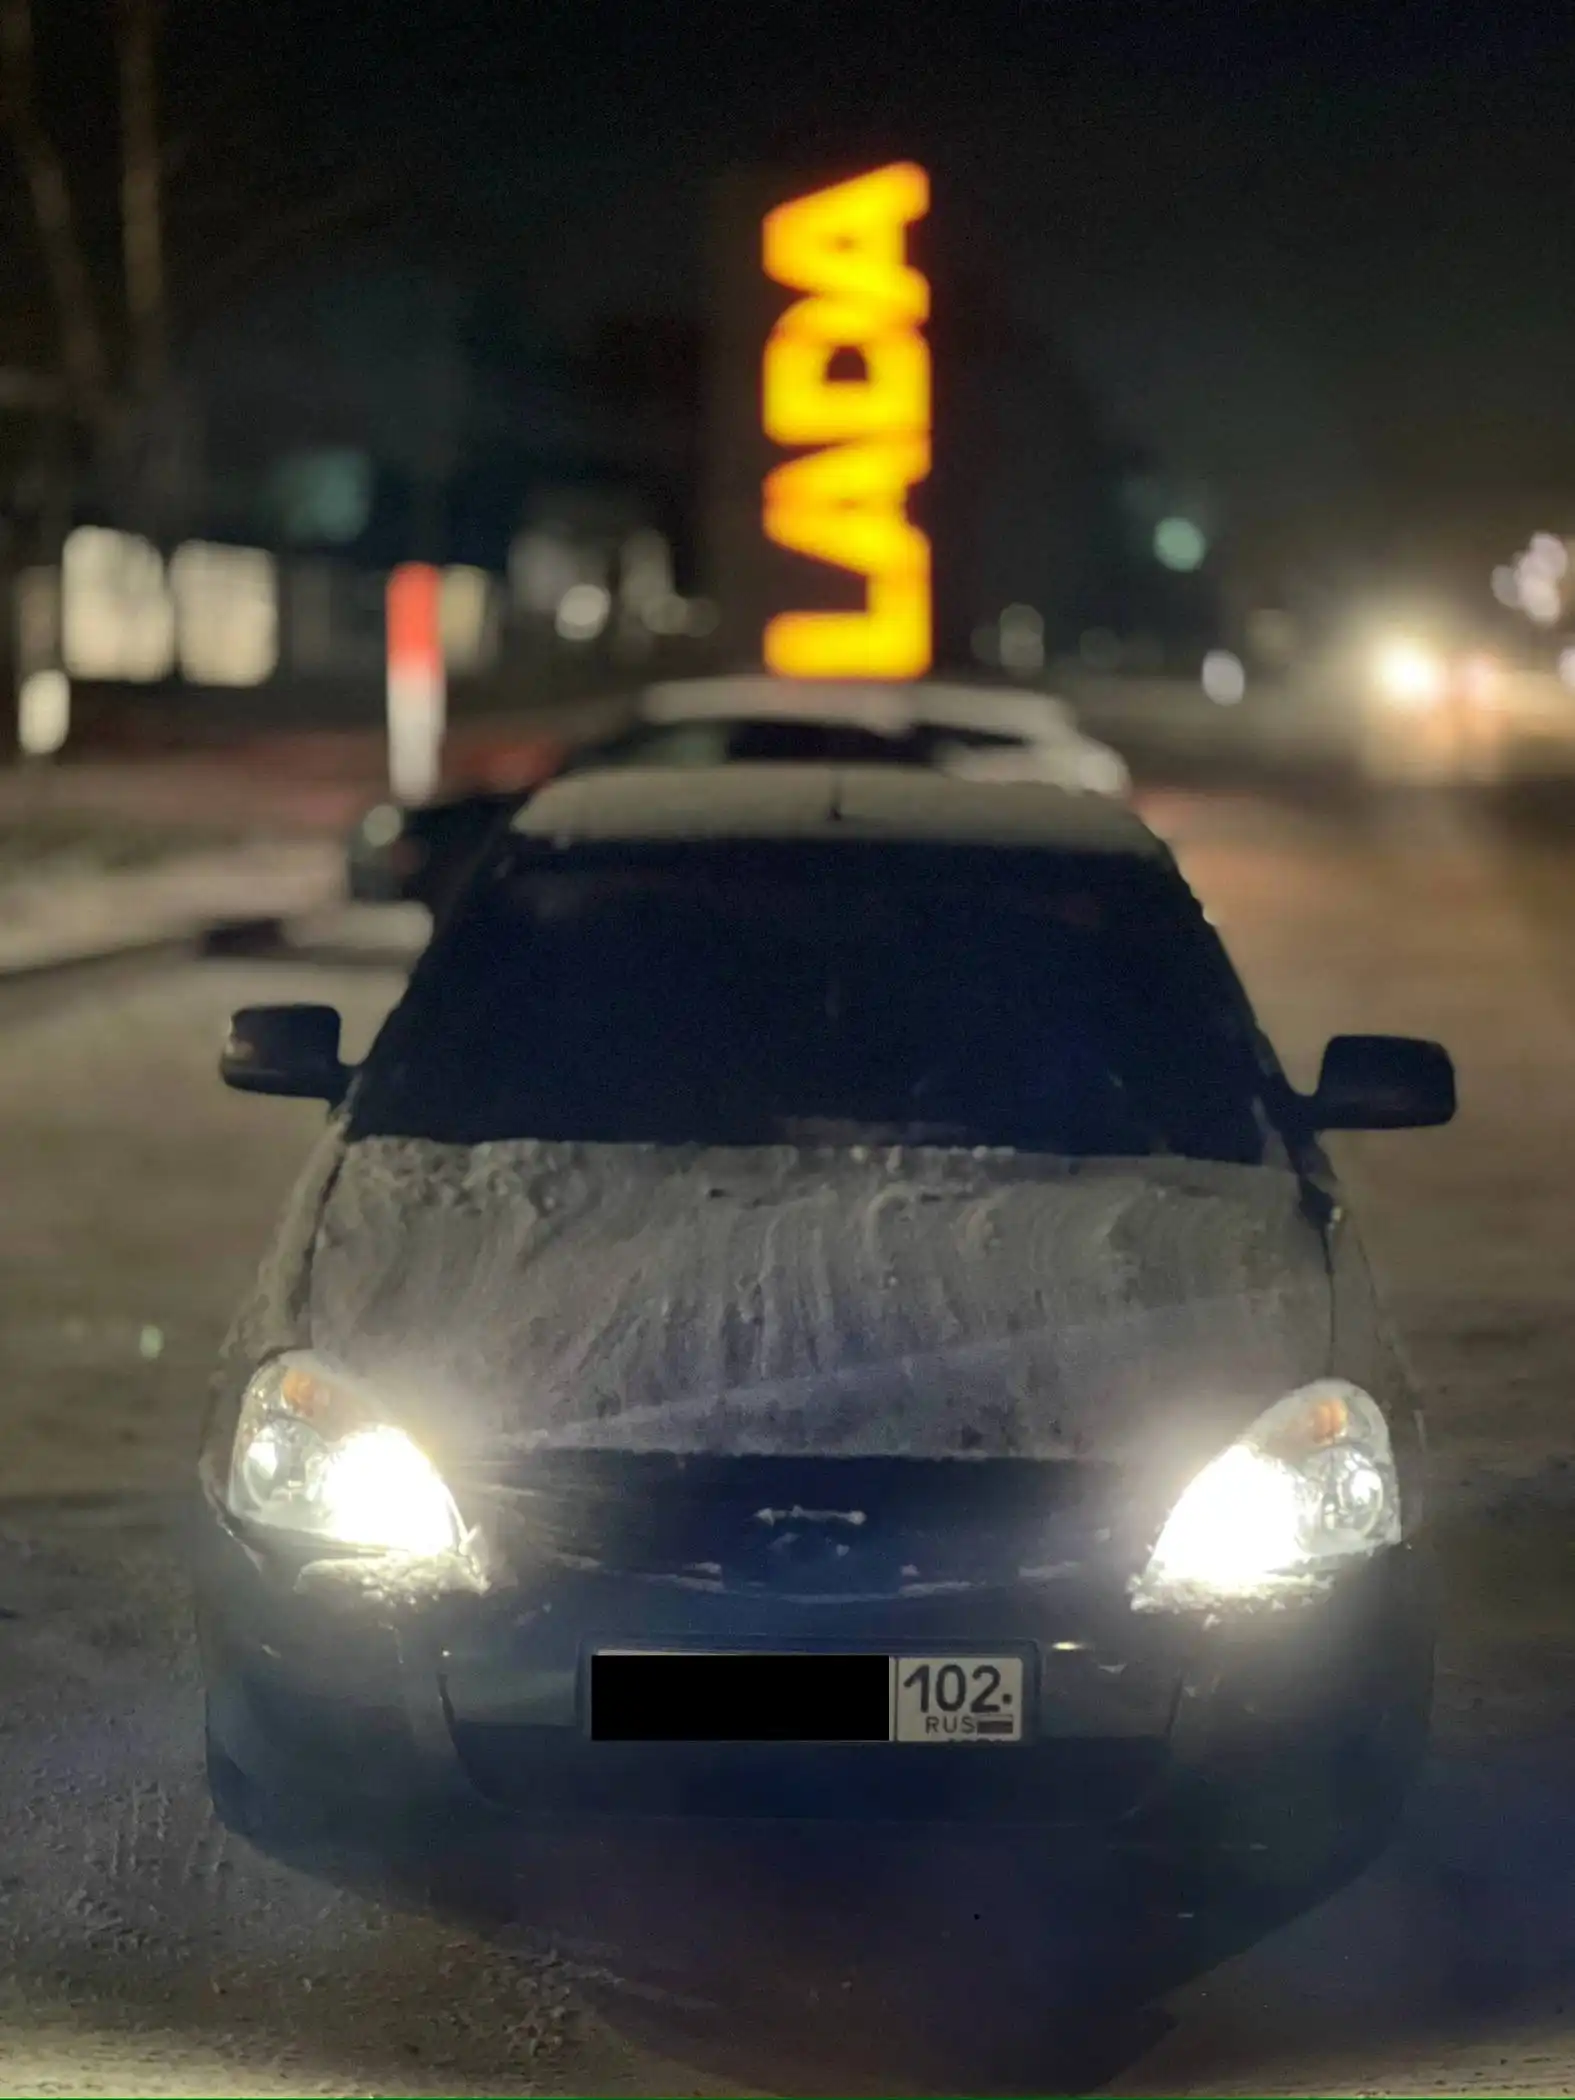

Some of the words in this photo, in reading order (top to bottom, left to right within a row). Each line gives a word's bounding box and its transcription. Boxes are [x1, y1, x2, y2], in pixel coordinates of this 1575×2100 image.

[763, 162, 931, 678] LADA
[903, 1664, 1001, 1713] 102
[926, 1716, 976, 1734] RUS
